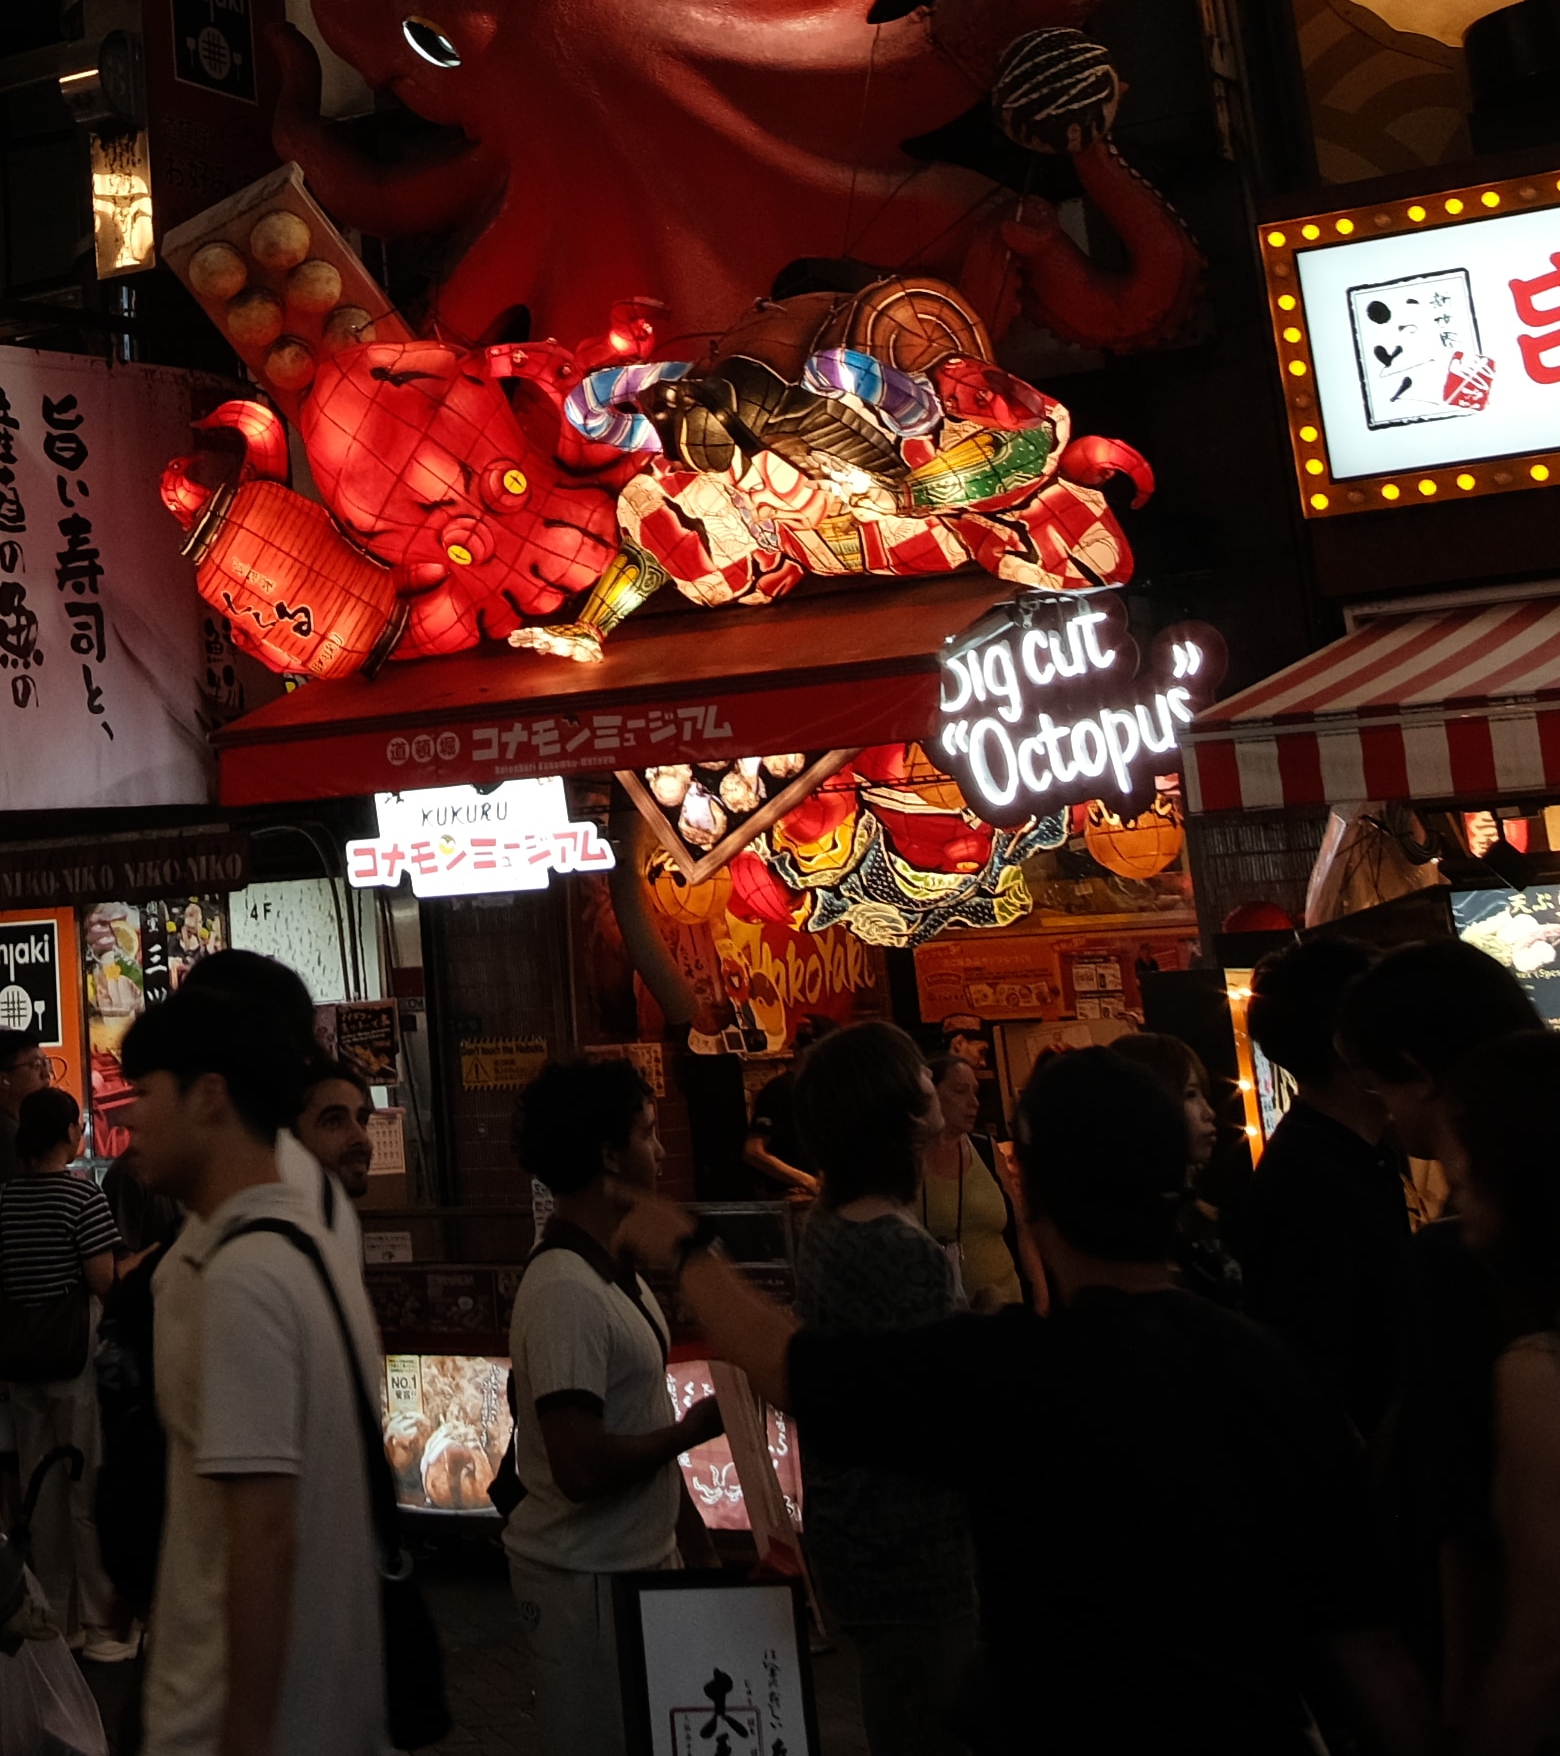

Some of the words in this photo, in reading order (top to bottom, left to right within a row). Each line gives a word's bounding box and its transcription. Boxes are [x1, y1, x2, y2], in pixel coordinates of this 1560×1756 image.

[42, 393, 115, 742] 旨い寿司と、
[1023, 611, 1116, 686] cut
[385, 730, 462, 767] 道頓堀
[472, 704, 732, 762] コナモンミュージアム
[421, 800, 509, 828] KUKURU
[353, 830, 610, 879] コナモンミュージアム
[249, 902, 273, 921] 4F
[391, 1374, 417, 1391] NO.1
